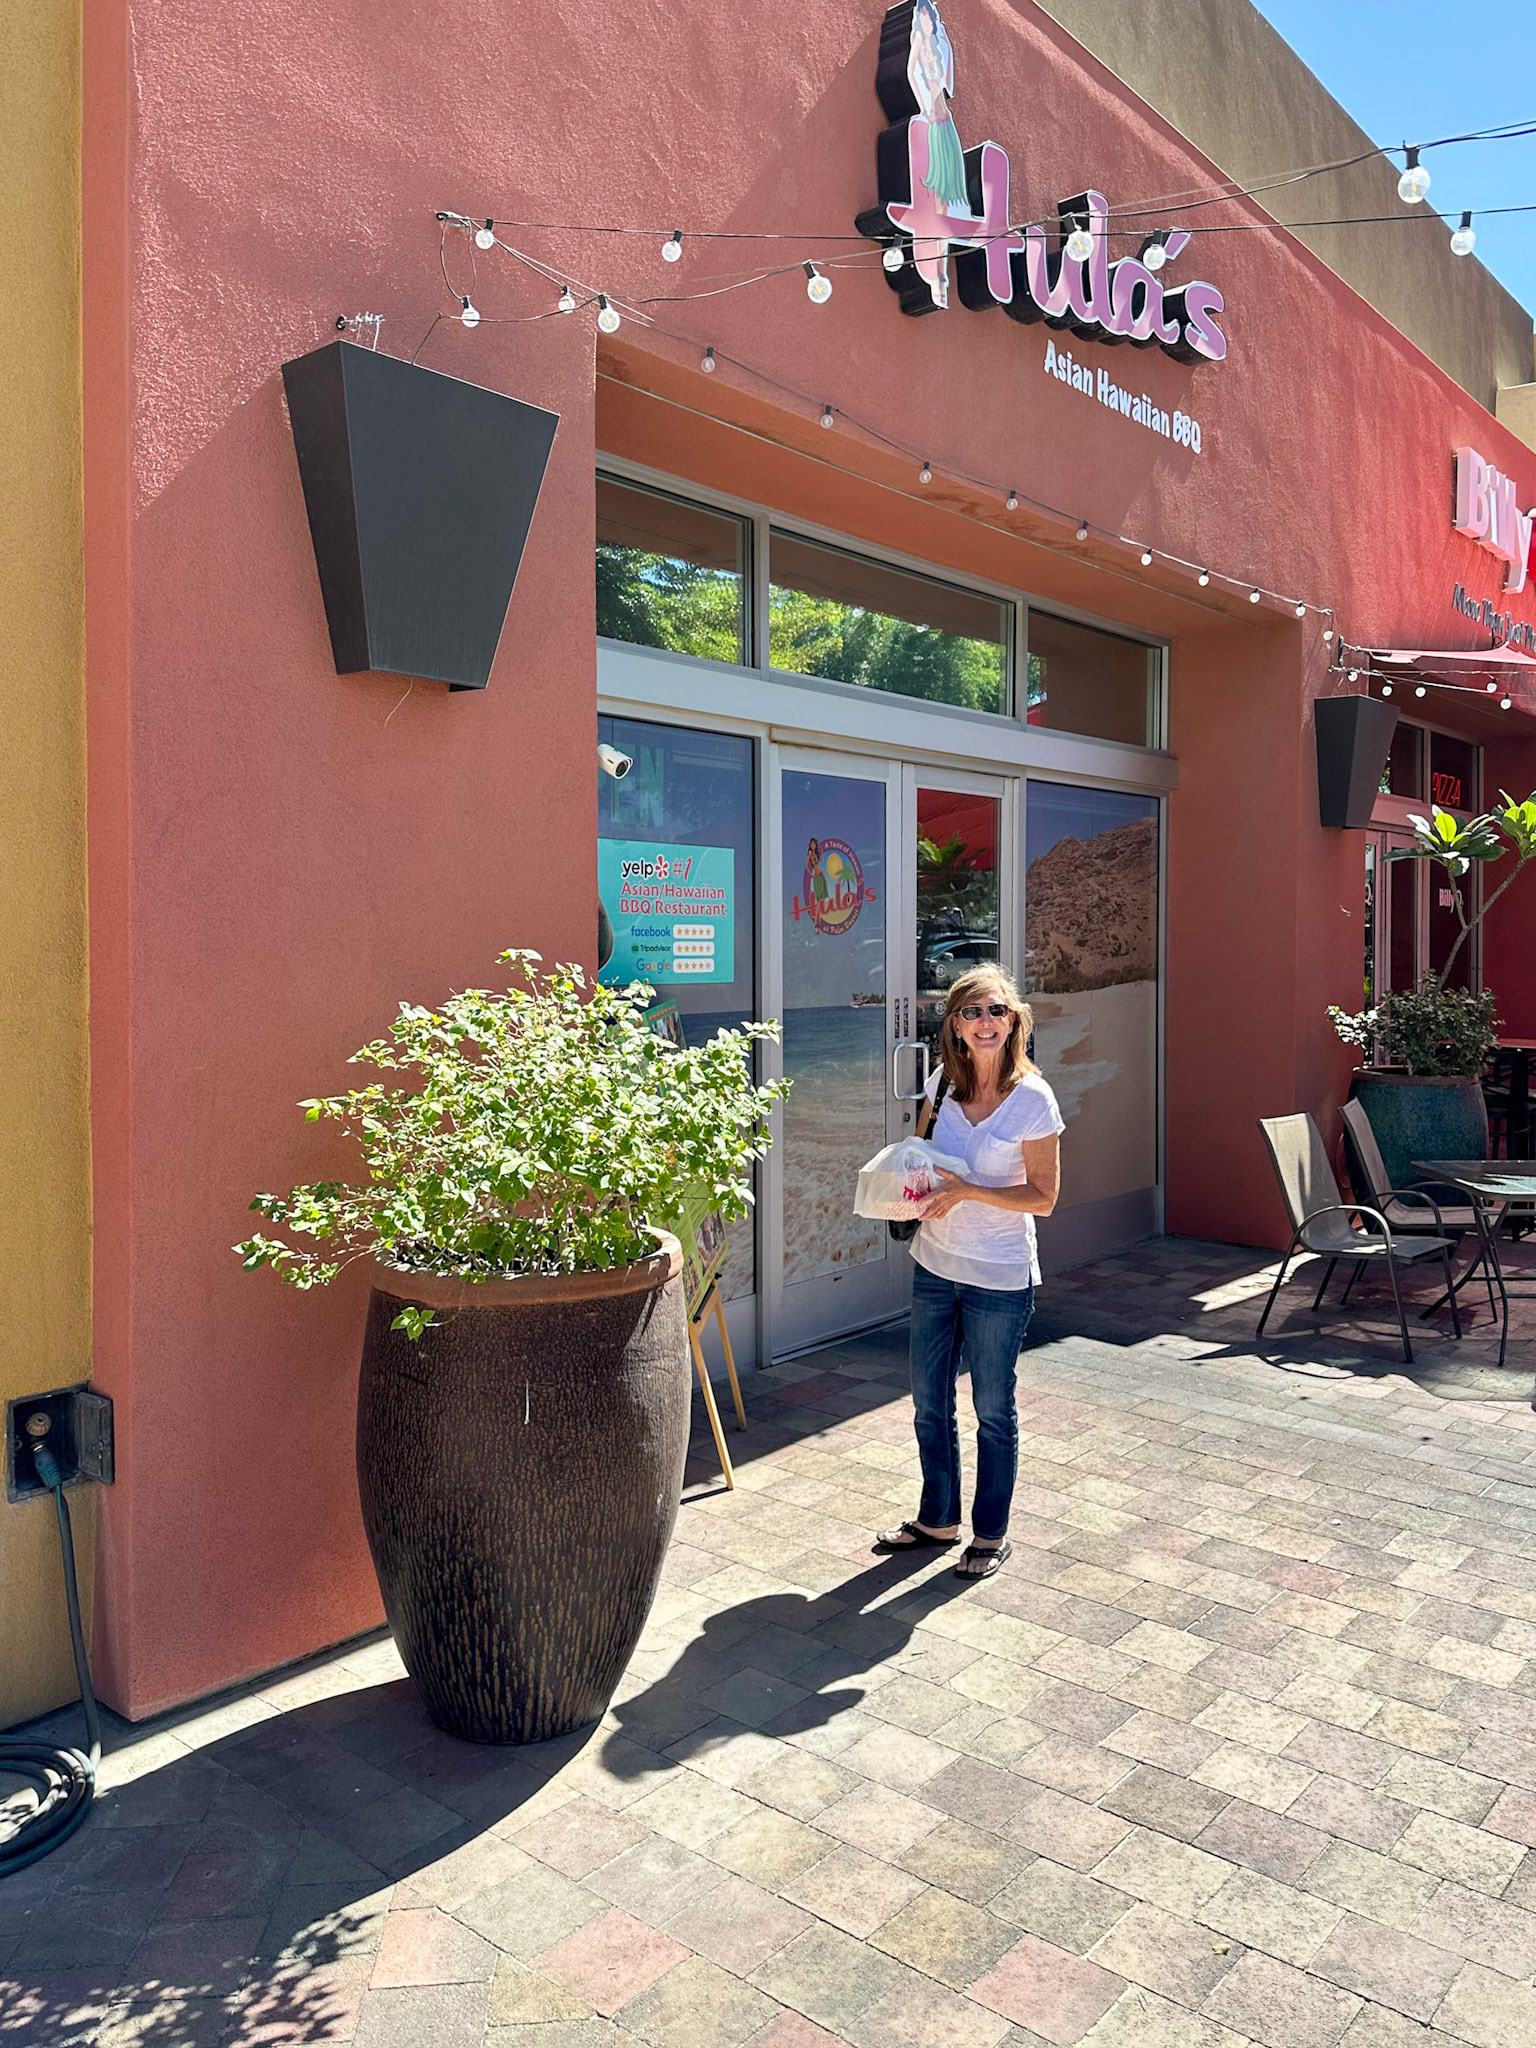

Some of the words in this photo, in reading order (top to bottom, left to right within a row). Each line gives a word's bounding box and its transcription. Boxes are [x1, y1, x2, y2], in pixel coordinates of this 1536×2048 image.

[887, 114, 1227, 360] Hula's
[1043, 338, 1094, 398] Asian
[1096, 367, 1171, 439] Hawaiian
[1172, 410, 1202, 455] BBQ
[1457, 446, 1533, 595] Billy
[1432, 771, 1461, 808] PIZZA
[621, 857, 655, 880] yelp
[671, 856, 693, 882] #1
[620, 880, 726, 901] Asian/Hawaiian
[620, 898, 652, 916] BBQ
[655, 899, 727, 917] Restaurant
[630, 924, 671, 938] facebook
[640, 944, 672, 953] Tripadvisor
[636, 958, 671, 975] Google
